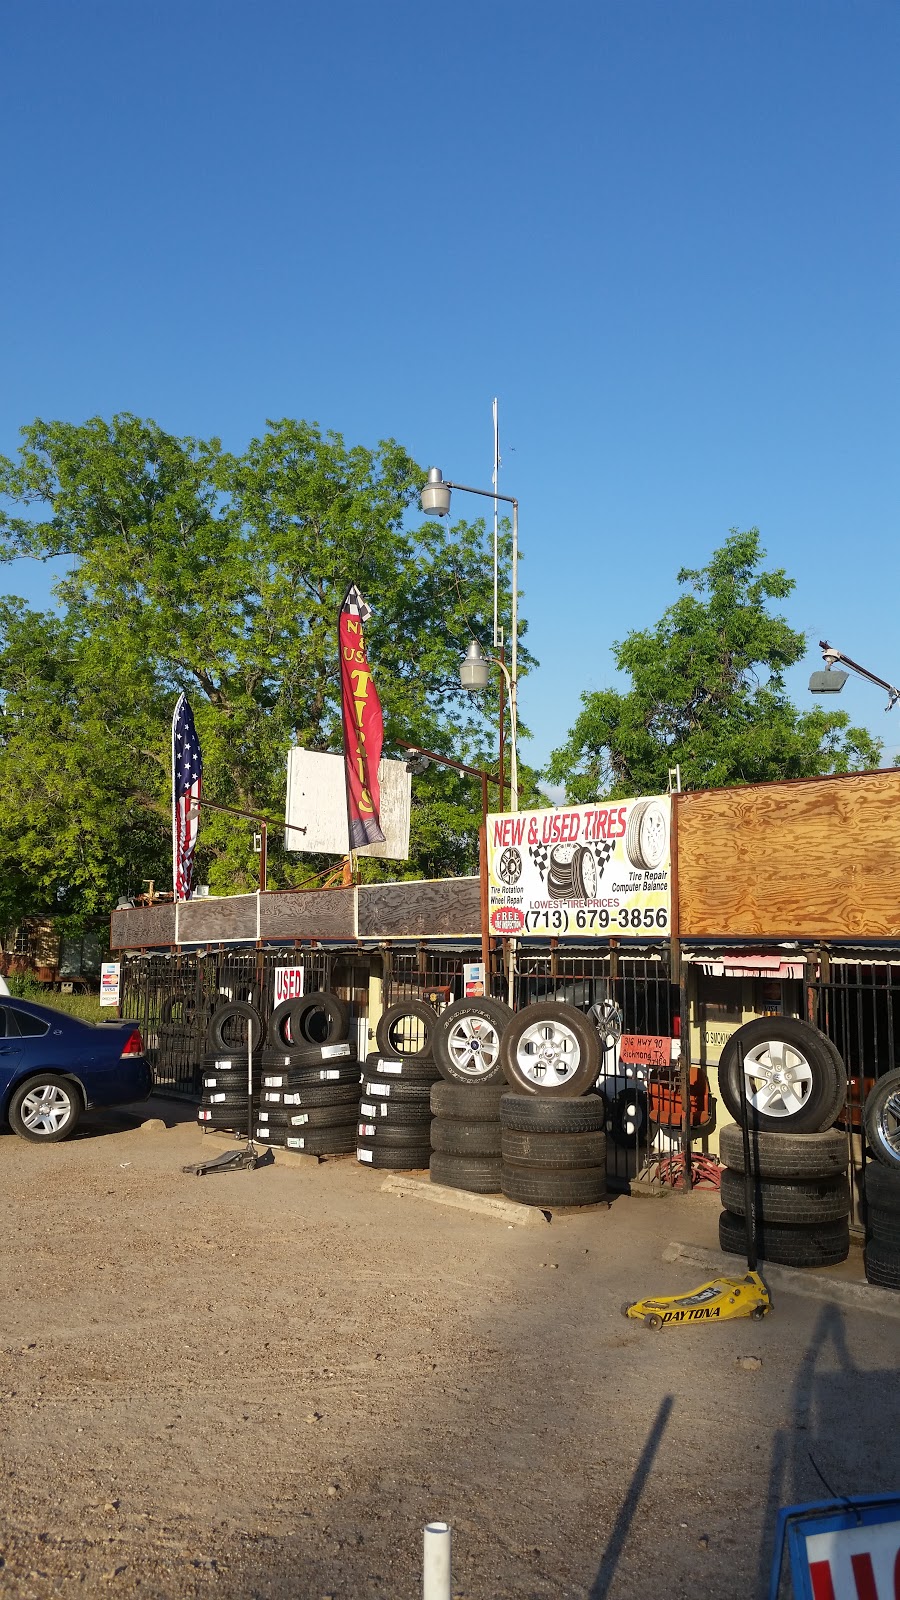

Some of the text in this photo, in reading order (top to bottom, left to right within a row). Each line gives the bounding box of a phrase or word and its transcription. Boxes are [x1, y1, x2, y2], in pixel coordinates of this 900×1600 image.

[493, 807, 627, 847] NEW & USED TIRES
[629, 870, 667, 881] Tire Repair
[490, 885, 524, 894] Tire Rotation
[612, 881, 668, 894] Computer Balance
[490, 895, 523, 906] Wheel Repair
[529, 900, 564, 909] LOWEST
[587, 898, 620, 908] PRICES
[496, 911, 520, 921] FREE
[524, 908, 668, 932] (713) 679-3856
[277, 970, 301, 1000] USED
[637, 1039, 653, 1047] HWY
[653, 1039, 663, 1049] 90
[622, 1049, 665, 1059] Richmond TX
[662, 1307, 721, 1323] DAYTONA
